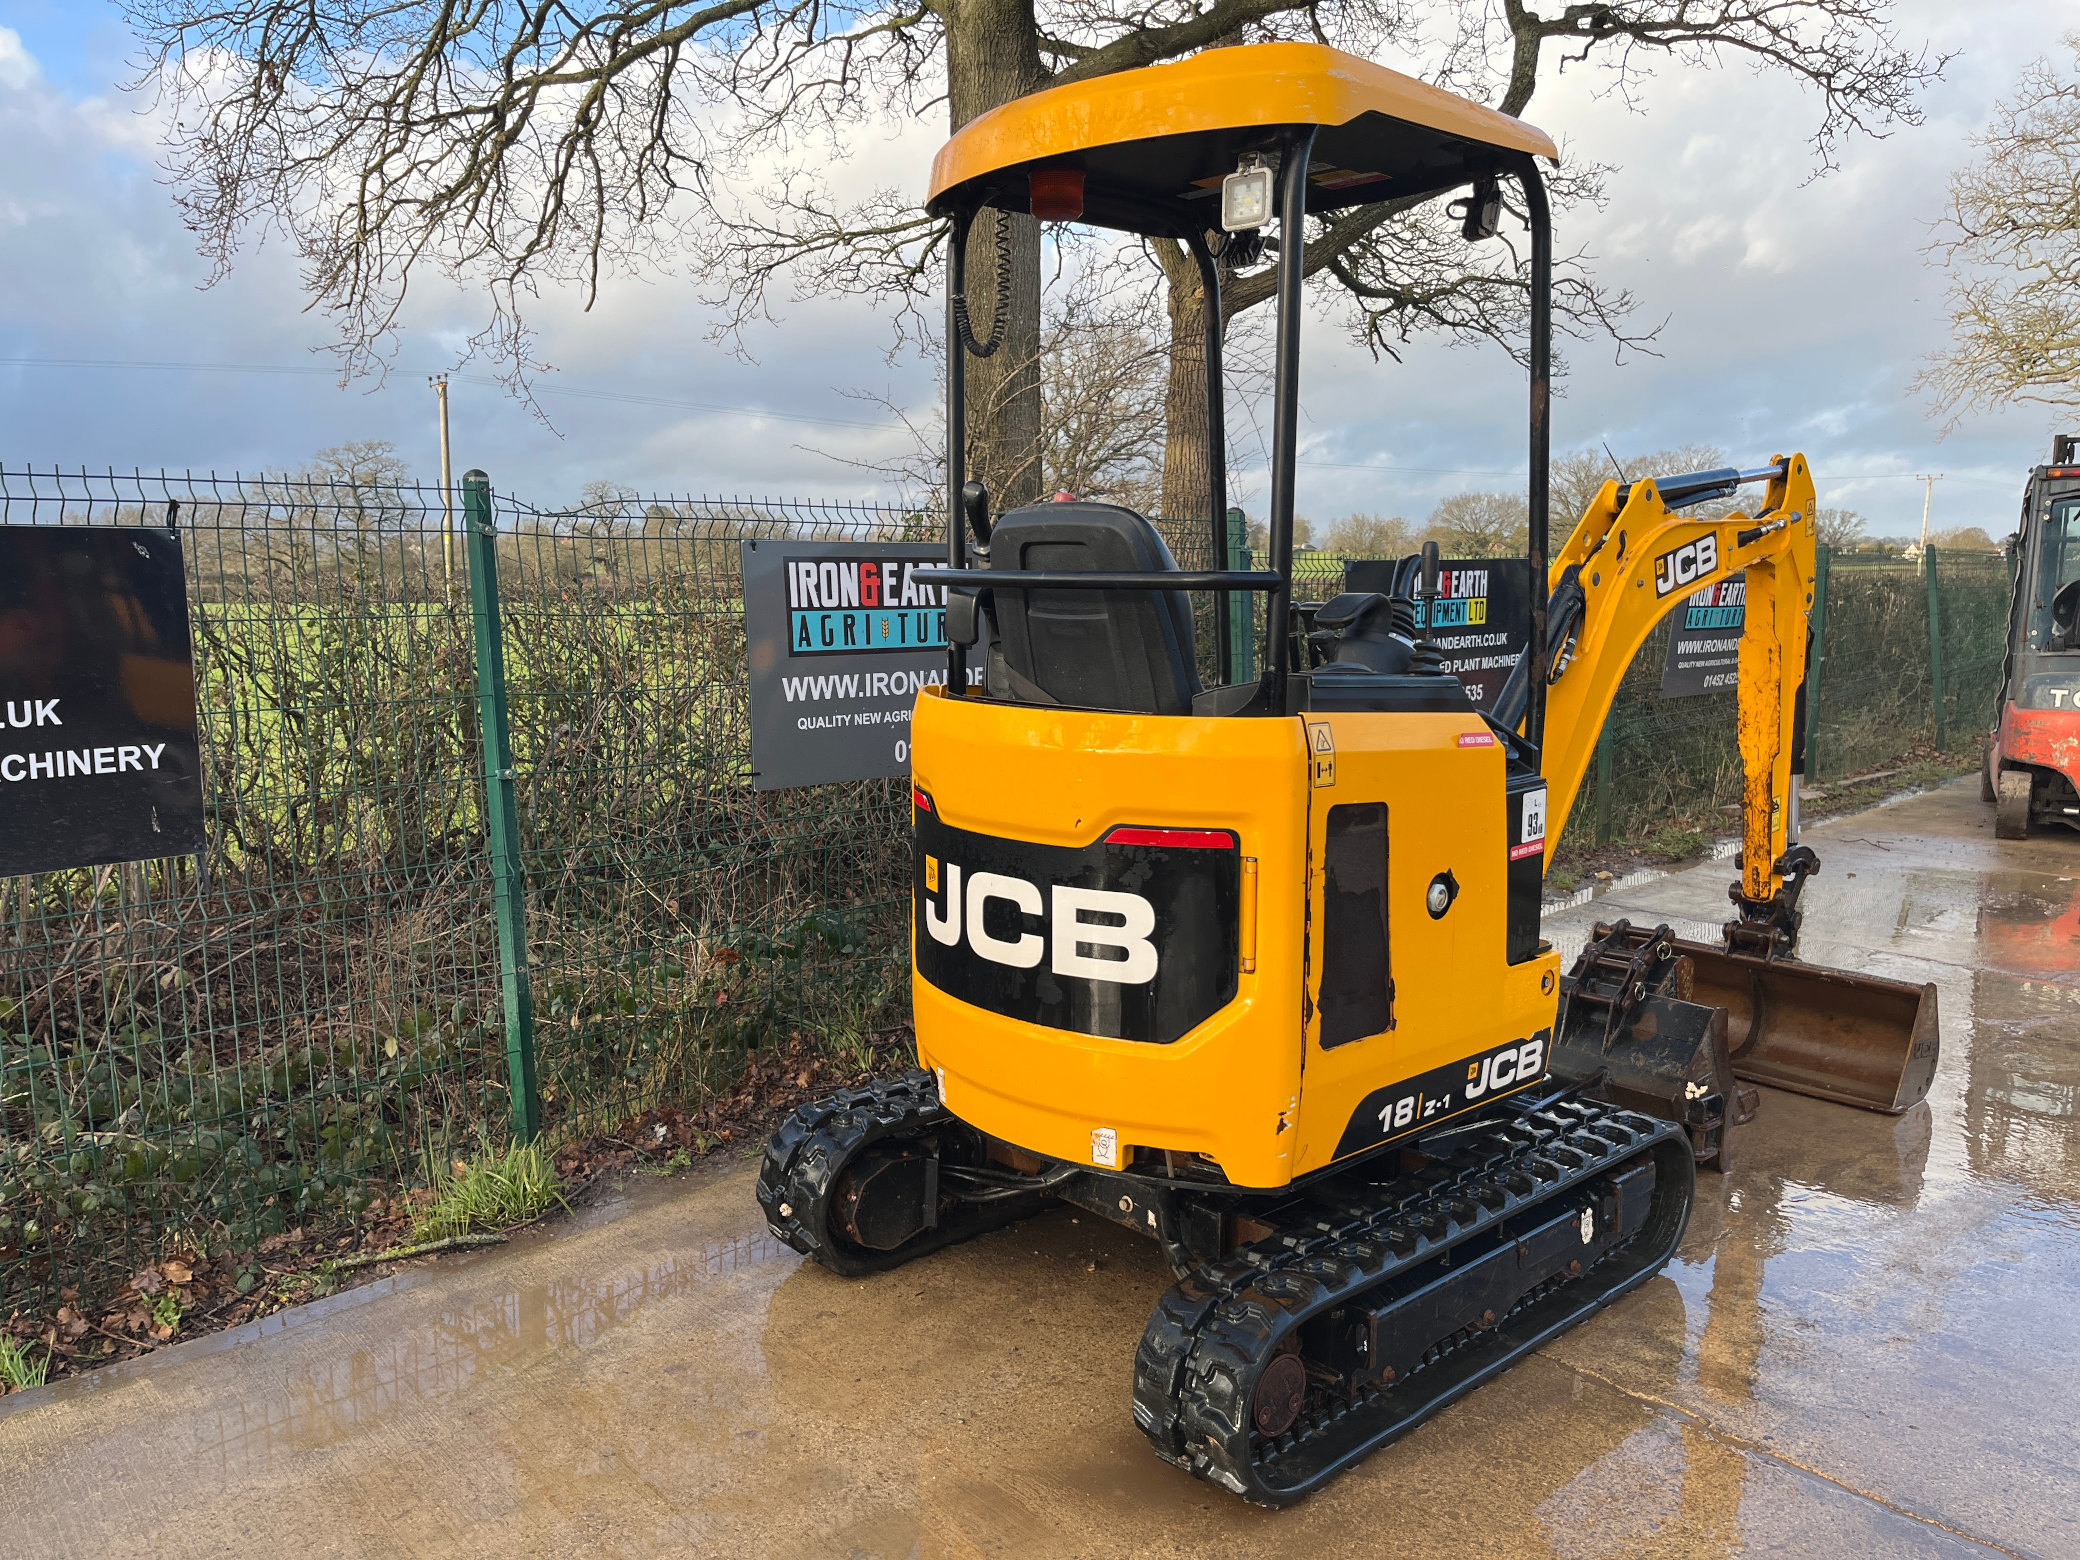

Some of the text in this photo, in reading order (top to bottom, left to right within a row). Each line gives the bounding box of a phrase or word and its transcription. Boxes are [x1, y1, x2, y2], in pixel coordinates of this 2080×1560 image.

[1656, 535, 1717, 594] JCB
[1414, 600, 1485, 625] EQIPMENT LTD
[1687, 609, 1714, 627] AGRI
[798, 611, 949, 648] AGRI TUR
[1440, 652, 1523, 673] ED PLANT MACHINER
[1725, 671, 1738, 685] 452
[798, 709, 912, 731] QUALITY NEW AGRI
[0, 743, 166, 783] CHINERY
[1527, 811, 1539, 837] 93
[925, 862, 1159, 984] JCB
[1465, 1039, 1544, 1100] JCB
[1378, 1095, 1415, 1133] 18
